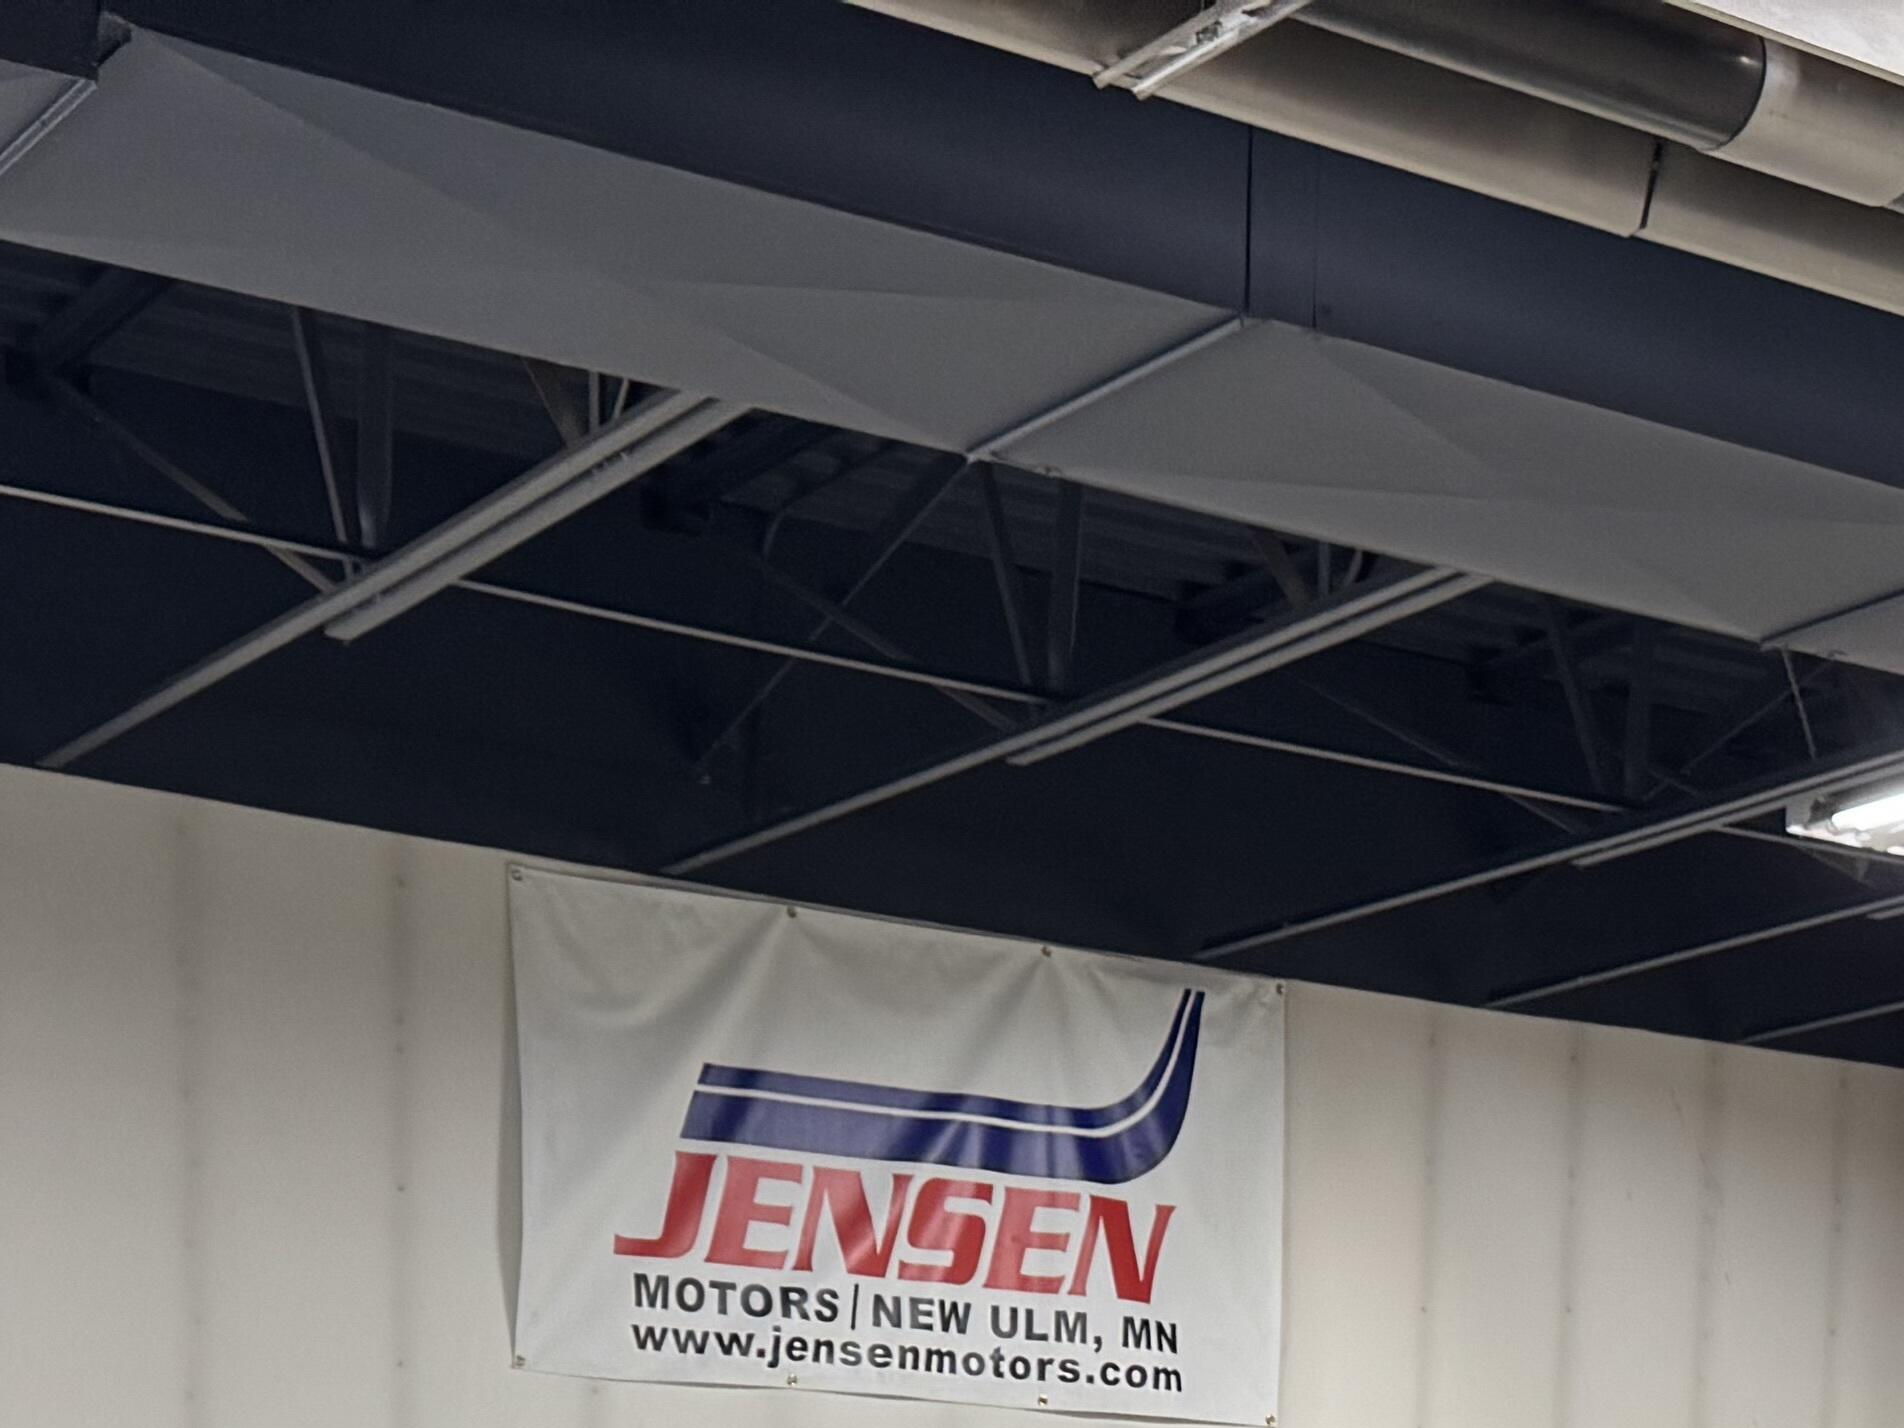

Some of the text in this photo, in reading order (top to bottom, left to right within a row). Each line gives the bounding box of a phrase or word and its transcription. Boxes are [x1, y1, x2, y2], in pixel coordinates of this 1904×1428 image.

[613, 1150, 1176, 1305] JENSEN
[633, 1273, 1179, 1354] MOTORS NEW ULM, MN
[632, 1323, 1183, 1392] www.jensenmotors.com
